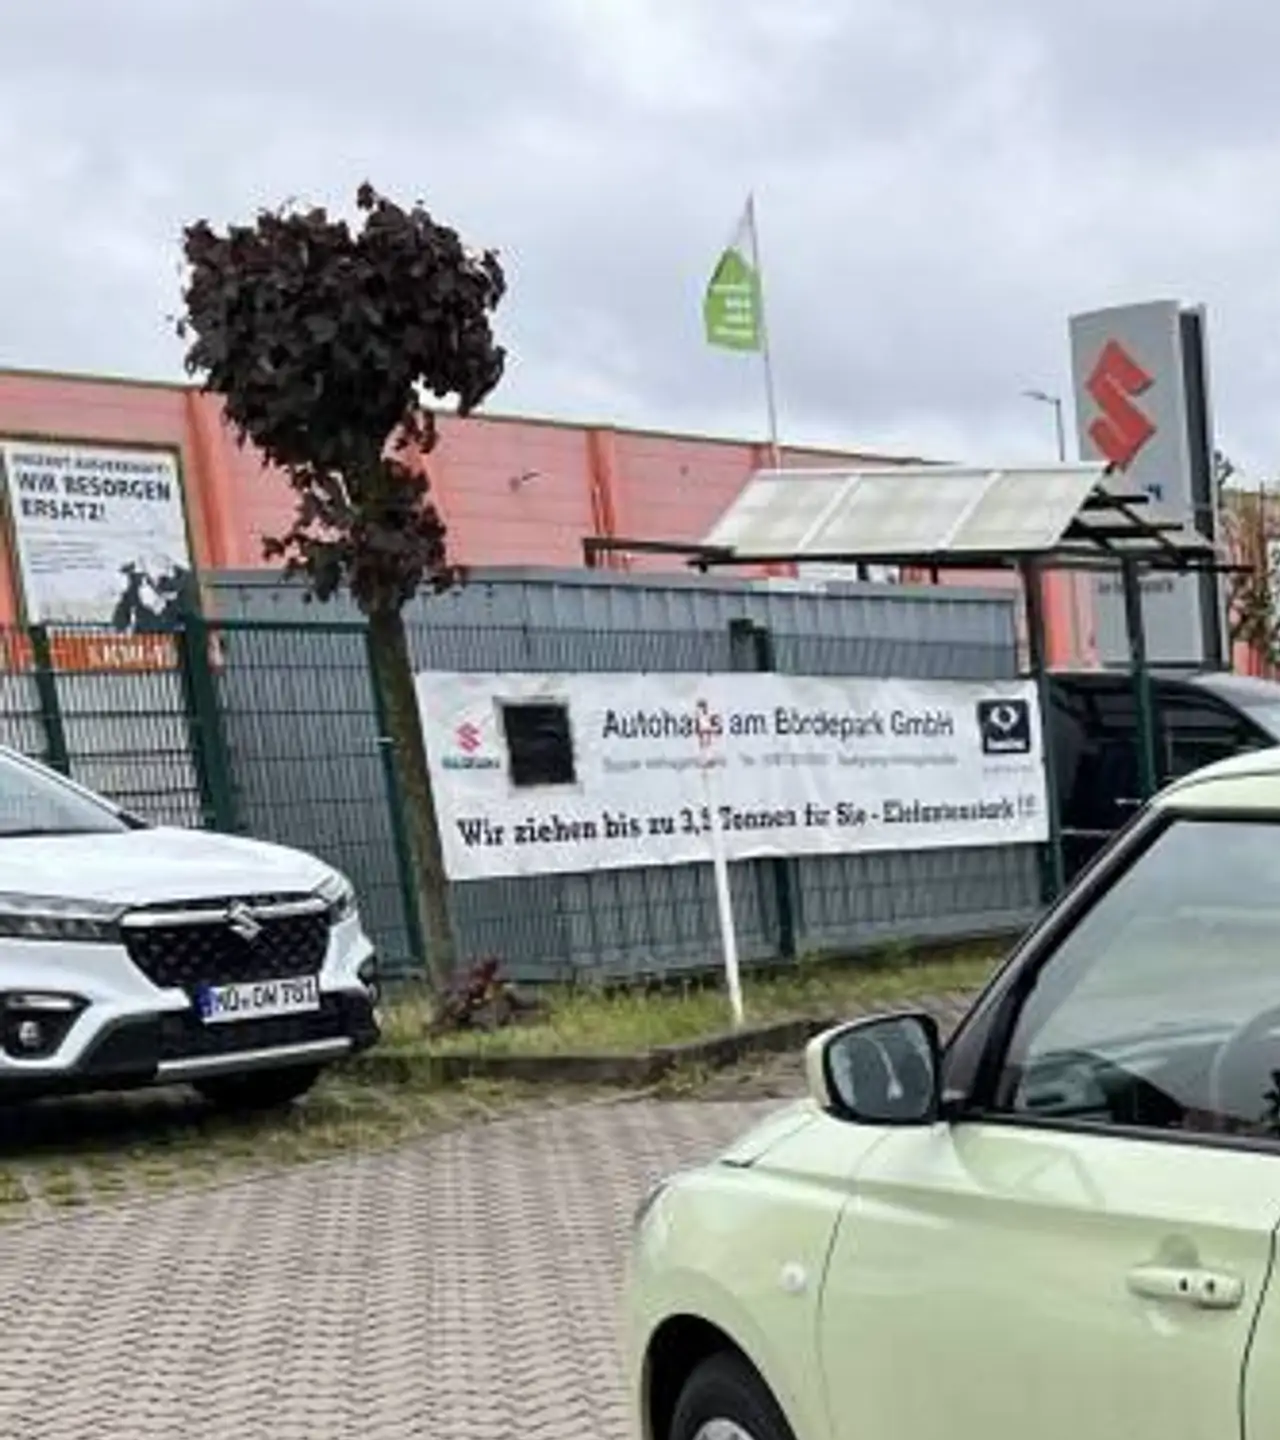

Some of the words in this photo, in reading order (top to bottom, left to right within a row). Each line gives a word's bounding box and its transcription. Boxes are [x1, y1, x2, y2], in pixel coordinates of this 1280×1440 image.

[17, 471, 57, 493] WIR
[63, 475, 171, 502] BESORGEN
[21, 498, 106, 521] ERSATZ!
[729, 711, 765, 736] am
[890, 709, 954, 736] GmbH
[456, 818, 503, 847] Wir
[514, 817, 597, 845] ziehen
[603, 811, 642, 838] bis
[649, 815, 674, 836] zu
